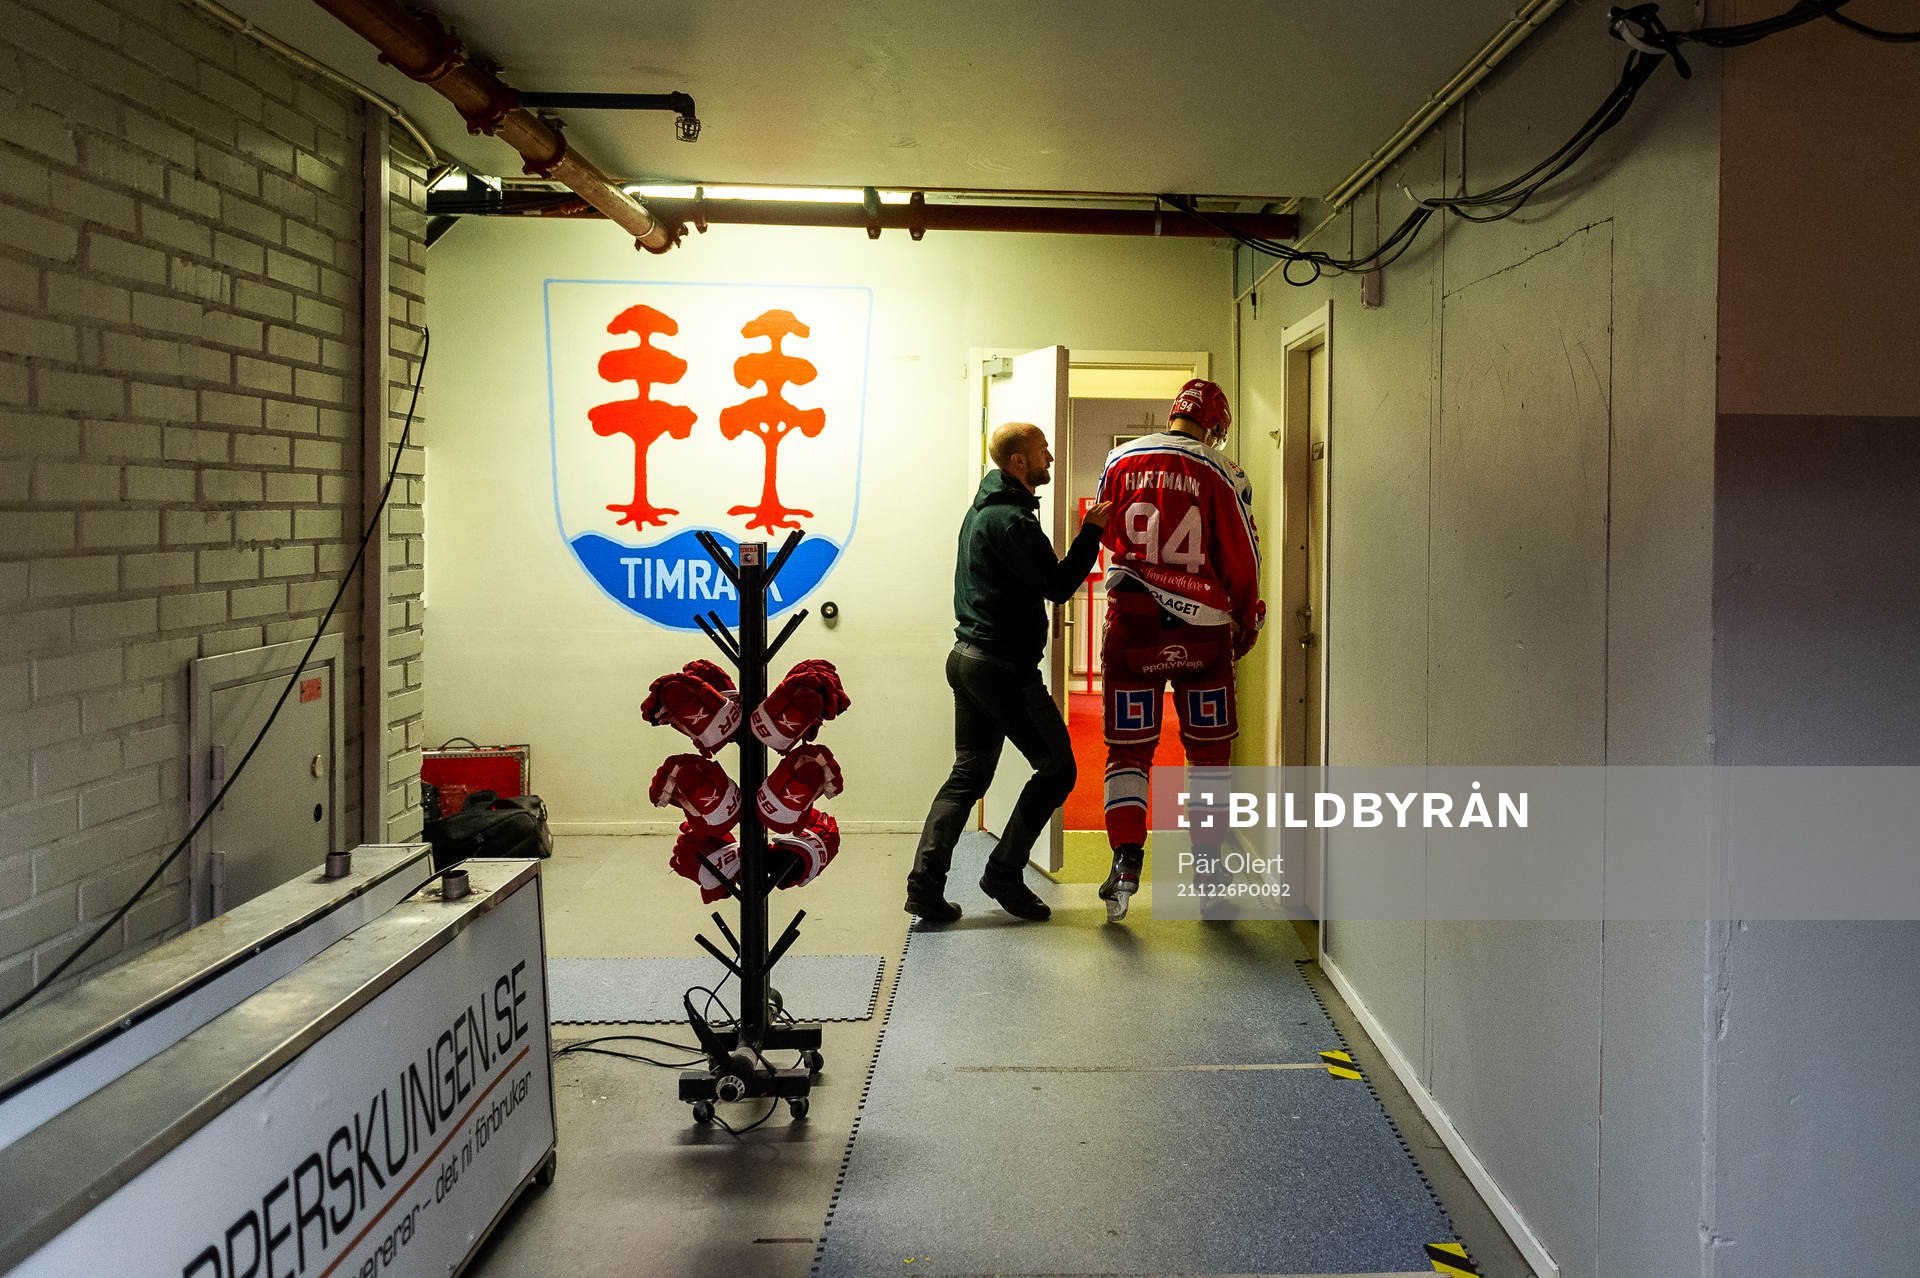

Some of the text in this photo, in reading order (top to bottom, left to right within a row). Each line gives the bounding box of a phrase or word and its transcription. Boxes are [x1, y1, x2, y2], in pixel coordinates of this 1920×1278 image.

[1180, 401, 1193, 412] 94
[1125, 470, 1200, 497] HARTMANN
[1125, 502, 1205, 573] 94
[1168, 575, 1186, 589] with
[435, 1154, 459, 1203] det
[462, 1129, 472, 1173] ni
[475, 1071, 531, 1154] förbrukar
